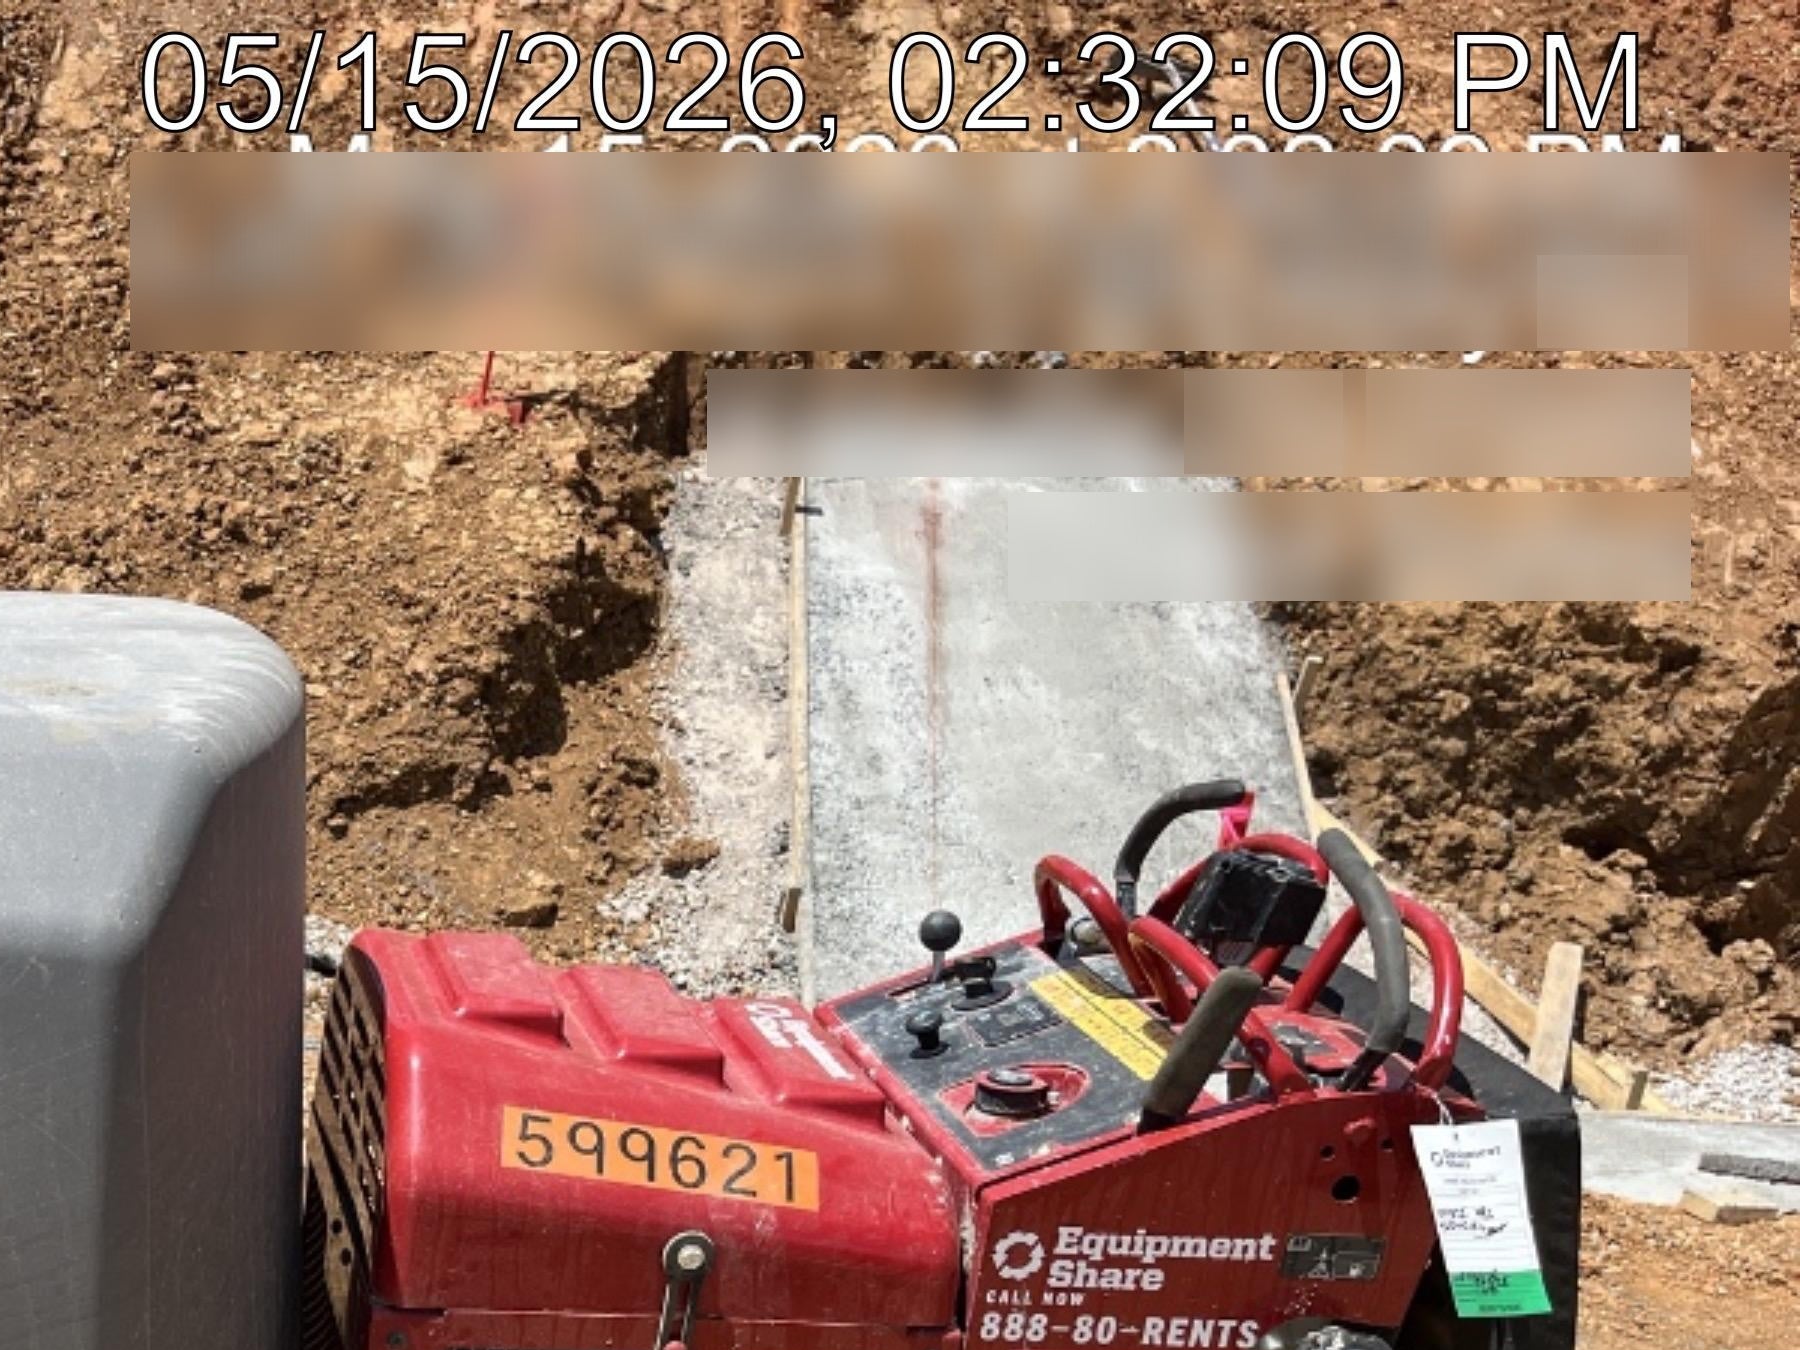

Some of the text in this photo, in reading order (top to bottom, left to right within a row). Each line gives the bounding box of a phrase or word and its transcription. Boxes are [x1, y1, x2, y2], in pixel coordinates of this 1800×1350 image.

[516, 1112, 795, 1202] 599621
[1054, 1226, 1276, 1262] Equipment
[1048, 1260, 1164, 1291] Share
[986, 1290, 1086, 1306] CALL NOW
[980, 1312, 1261, 1349] 888-80-RENTS
